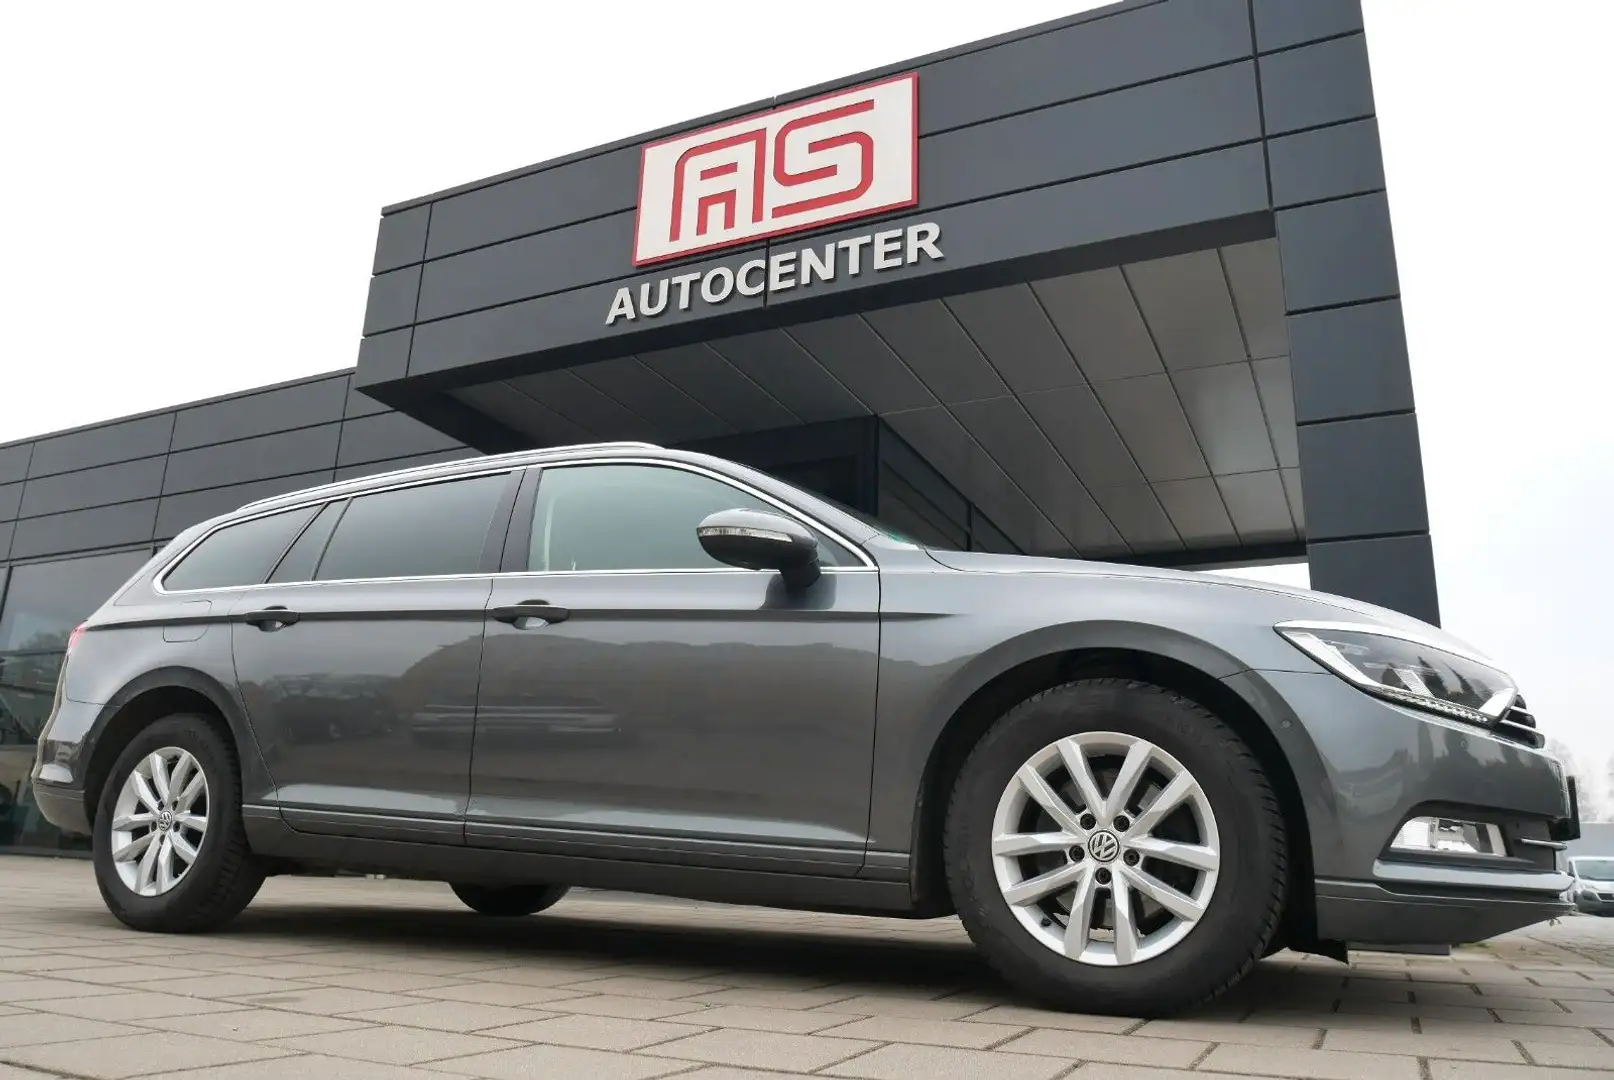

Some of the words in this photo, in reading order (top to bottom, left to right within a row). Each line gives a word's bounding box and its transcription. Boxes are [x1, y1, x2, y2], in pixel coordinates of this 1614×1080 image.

[669, 98, 875, 242] AS
[605, 222, 945, 325] AUTOCENTER
[1089, 831, 1119, 861] VW
